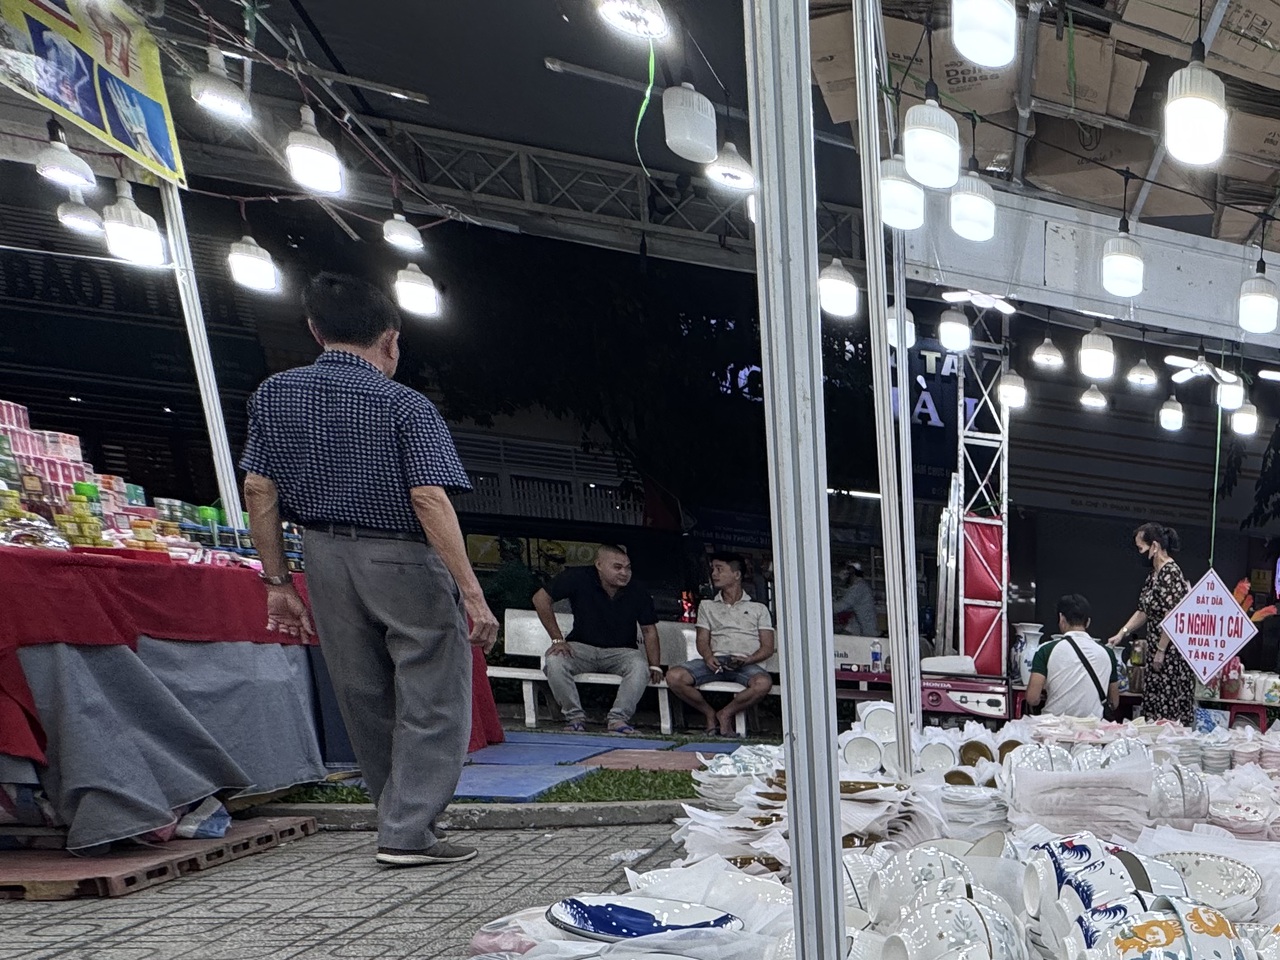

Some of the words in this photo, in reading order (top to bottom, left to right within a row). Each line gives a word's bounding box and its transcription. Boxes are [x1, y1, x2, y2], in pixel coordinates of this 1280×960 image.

[1174, 612, 1186, 634] 15
[1187, 609, 1217, 637] NGHÌN
[1219, 615, 1224, 637] 1
[1227, 611, 1244, 639] CÁI
[1188, 637, 1210, 648] MUA
[1214, 639, 1226, 649] 10
[1188, 649, 1215, 662] TẶNG
[1218, 652, 1225, 662] 2
